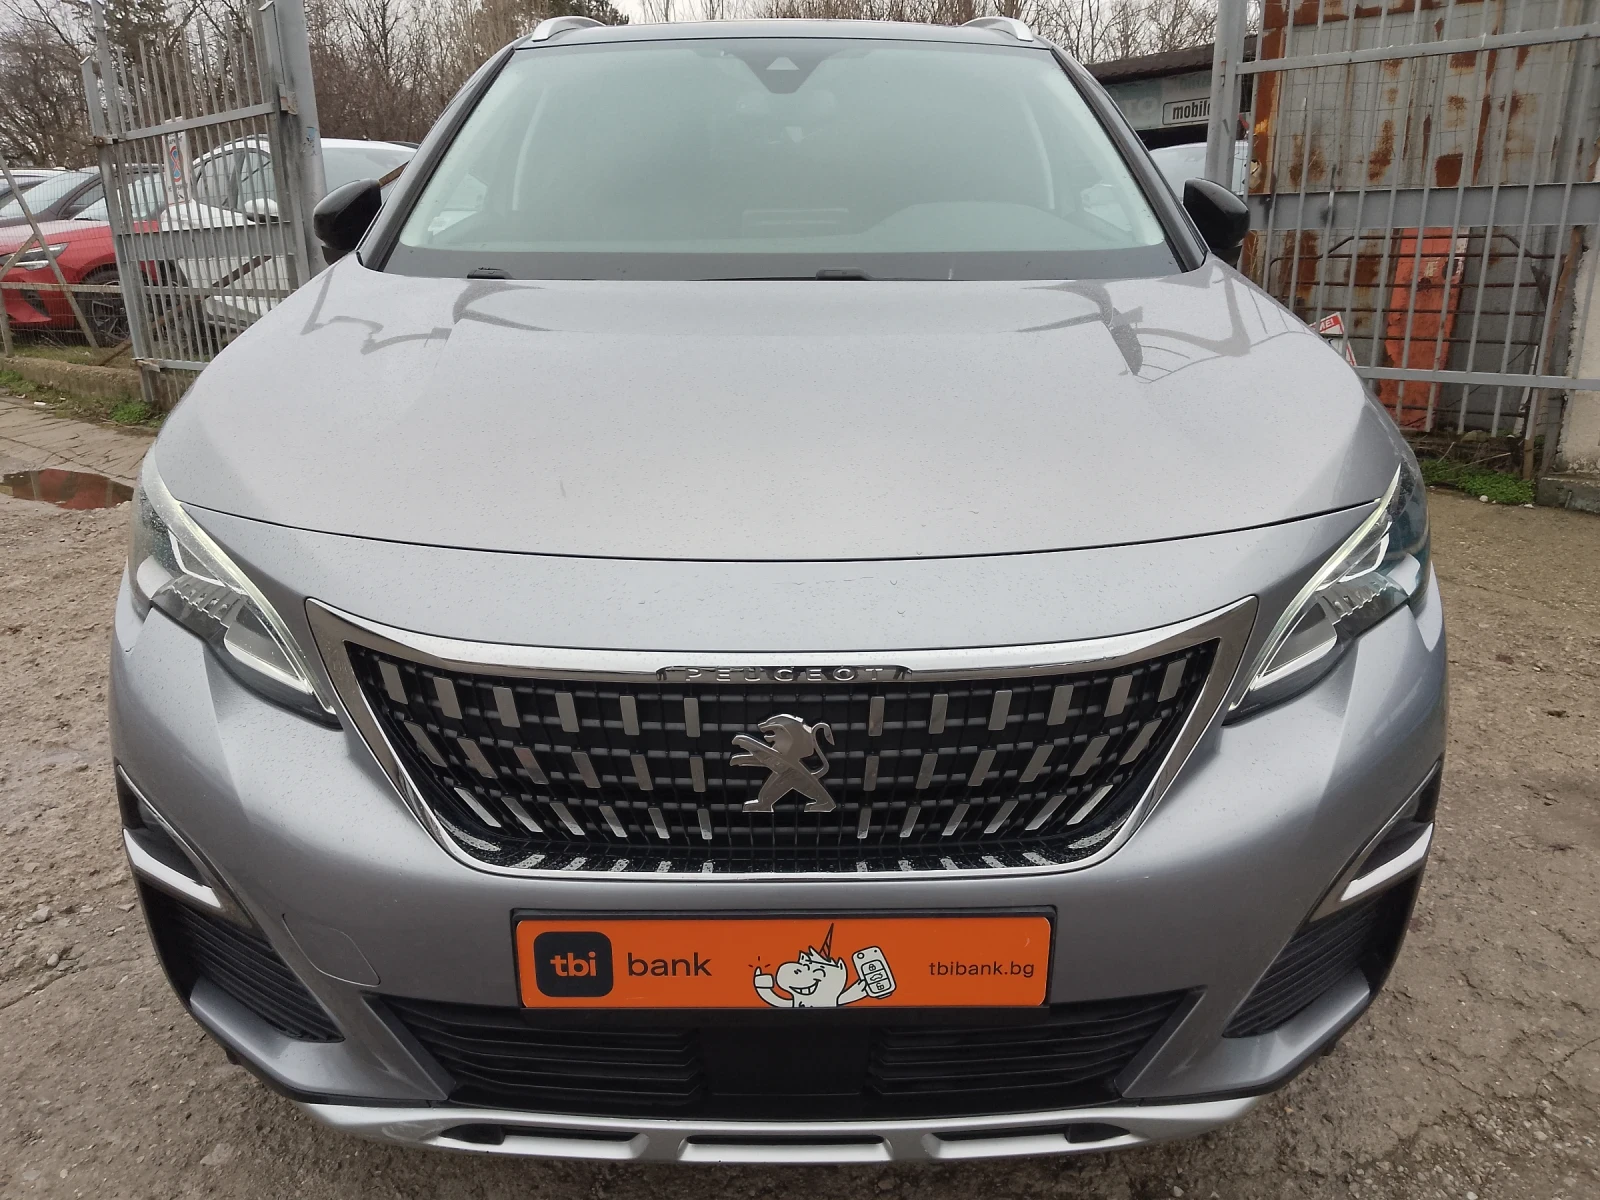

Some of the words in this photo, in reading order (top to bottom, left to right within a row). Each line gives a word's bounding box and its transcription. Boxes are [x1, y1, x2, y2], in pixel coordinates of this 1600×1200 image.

[684, 668, 883, 682] PEUGEOT
[550, 951, 597, 977] tbi
[628, 952, 712, 977] bank
[929, 961, 1035, 978] tbibank.bg
